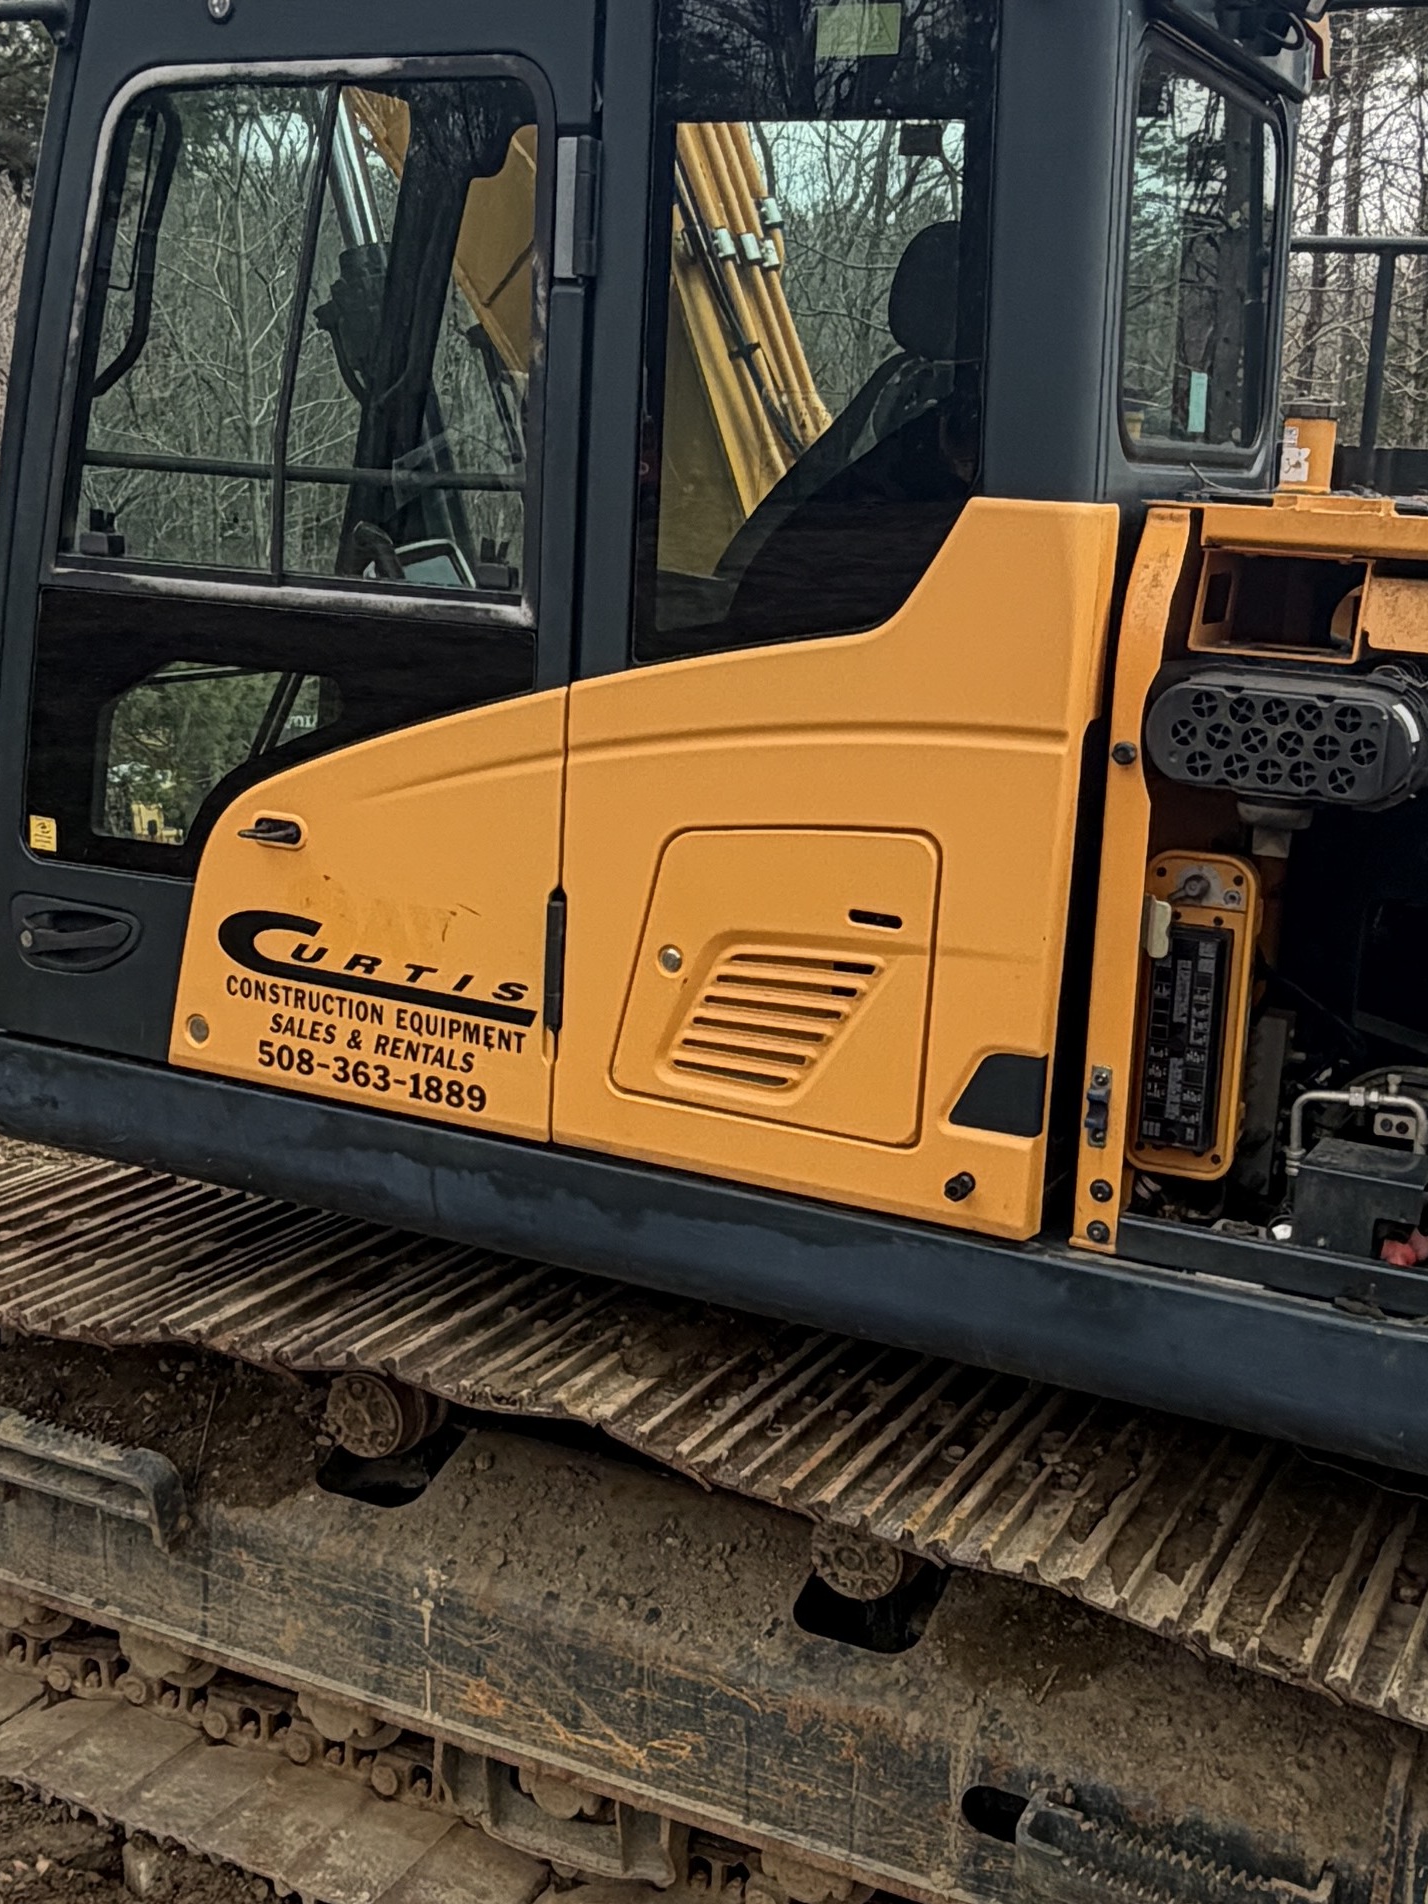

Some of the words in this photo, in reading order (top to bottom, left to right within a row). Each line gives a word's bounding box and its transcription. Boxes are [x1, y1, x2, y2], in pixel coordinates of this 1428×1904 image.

[219, 910, 534, 1010] CURTIS
[226, 974, 384, 1026] CONSTRUCTION
[396, 1008, 527, 1054] EQUIPMENT
[269, 1012, 336, 1045] SALES
[346, 1028, 363, 1051] &
[374, 1036, 475, 1073] RENTALS
[257, 1039, 487, 1113] 508-363-1889
